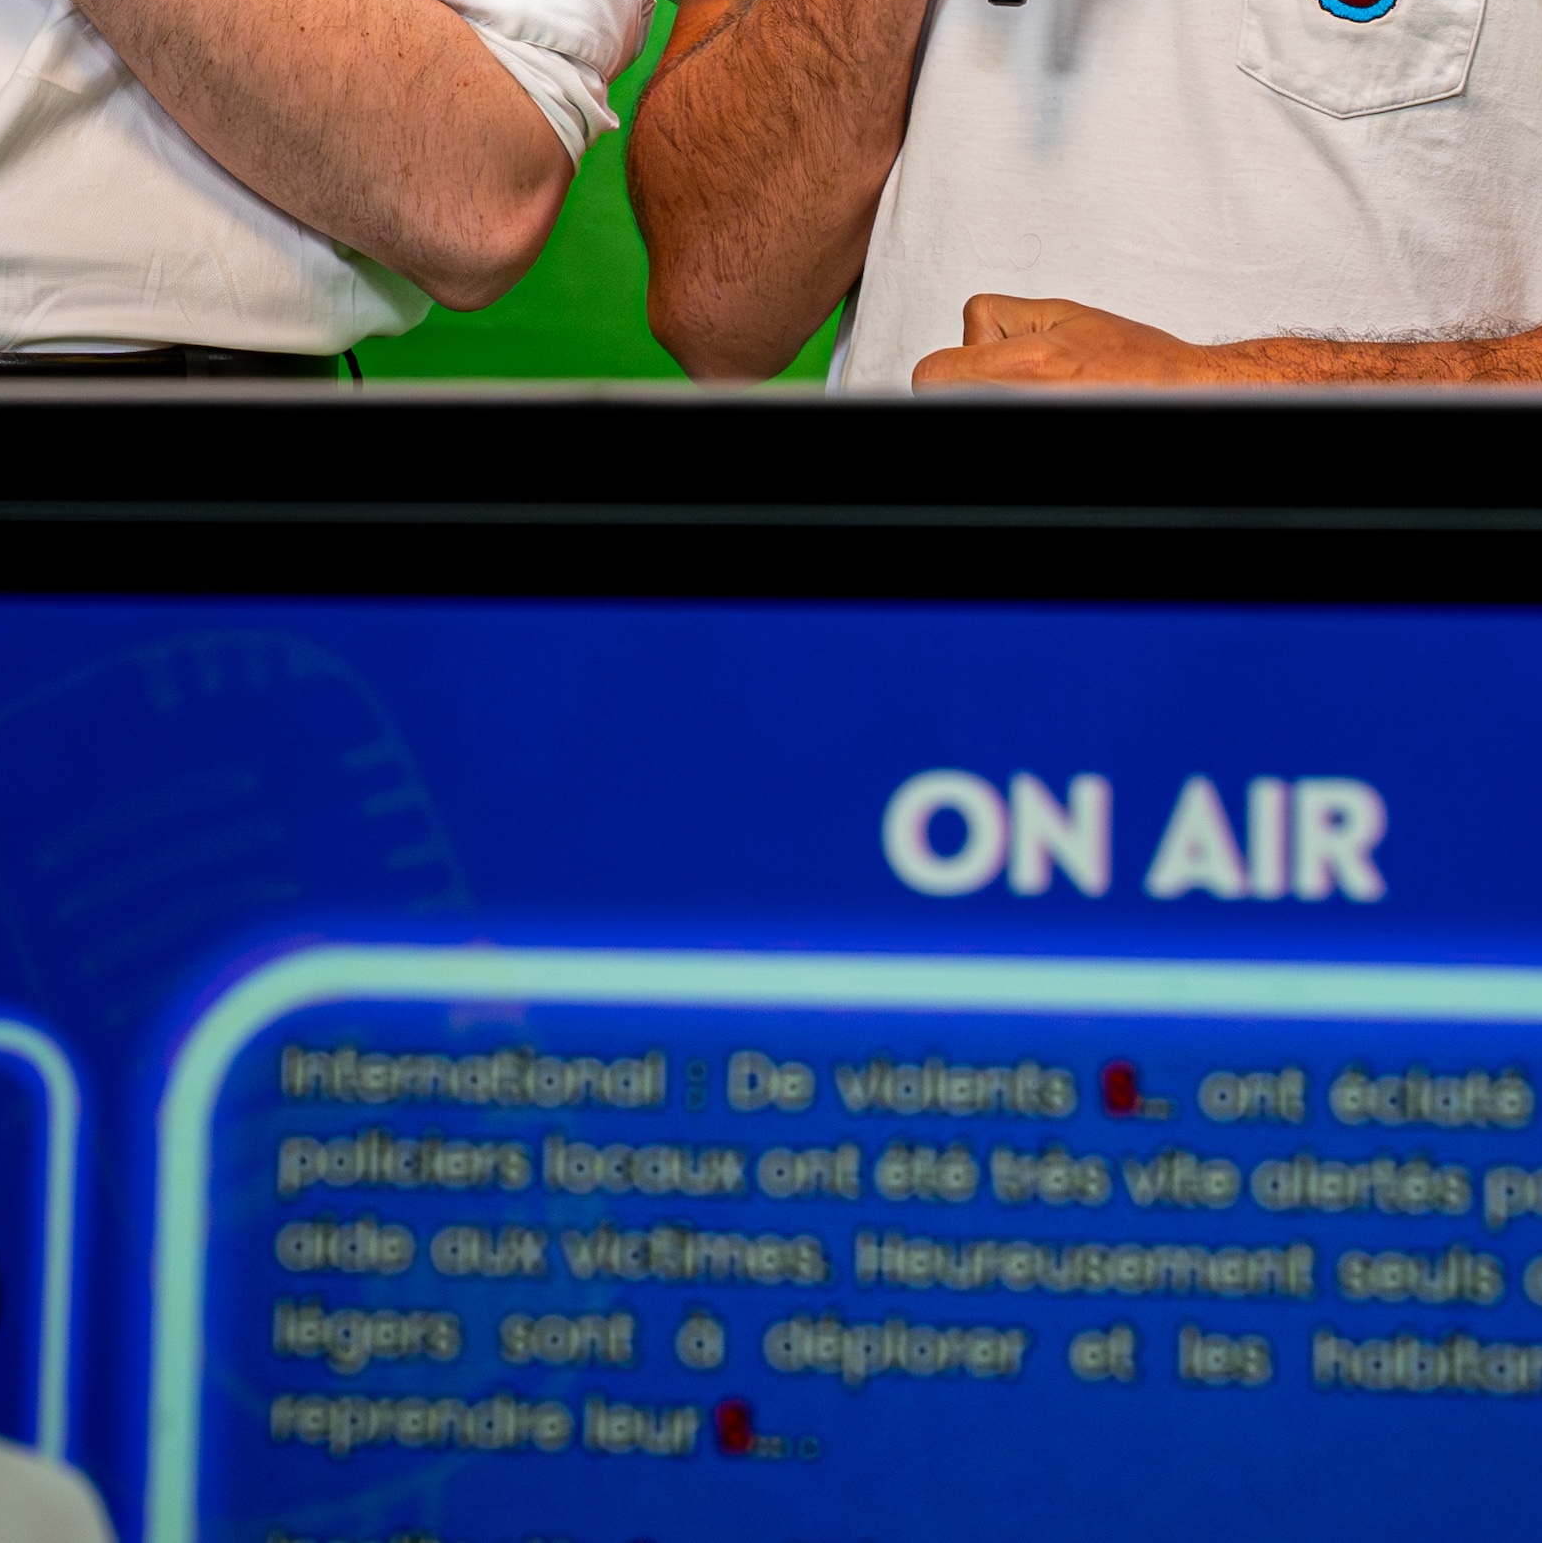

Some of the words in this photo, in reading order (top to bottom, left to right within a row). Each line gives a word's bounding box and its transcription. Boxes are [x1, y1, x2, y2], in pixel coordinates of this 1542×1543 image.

[880, 767, 1114, 900] ON
[1142, 772, 1389, 904] AIR
[281, 1045, 666, 1108] International
[727, 1050, 816, 1112] De
[835, 1052, 1079, 1118] violents
[1198, 1065, 1307, 1125] ont
[1328, 1064, 1534, 1129] éclaté
[278, 1129, 531, 1195] policiers
[543, 1132, 746, 1195] locaux
[757, 1143, 861, 1200] ont
[874, 1140, 979, 1202] été
[1123, 1149, 1241, 1208] vite
[1251, 1153, 1473, 1215] alertés
[275, 1216, 415, 1275] aide
[430, 1225, 547, 1277] aux
[856, 1230, 1314, 1299] Heureusement
[1337, 1244, 1504, 1304] seuls
[274, 1298, 461, 1376] légers
[499, 1312, 635, 1367] sont
[675, 1309, 725, 1371] à
[763, 1313, 1028, 1389] déplorer
[1068, 1323, 1136, 1382] et
[1178, 1324, 1272, 1385] les
[271, 1393, 575, 1456] reprendre
[583, 1395, 699, 1454] leur
